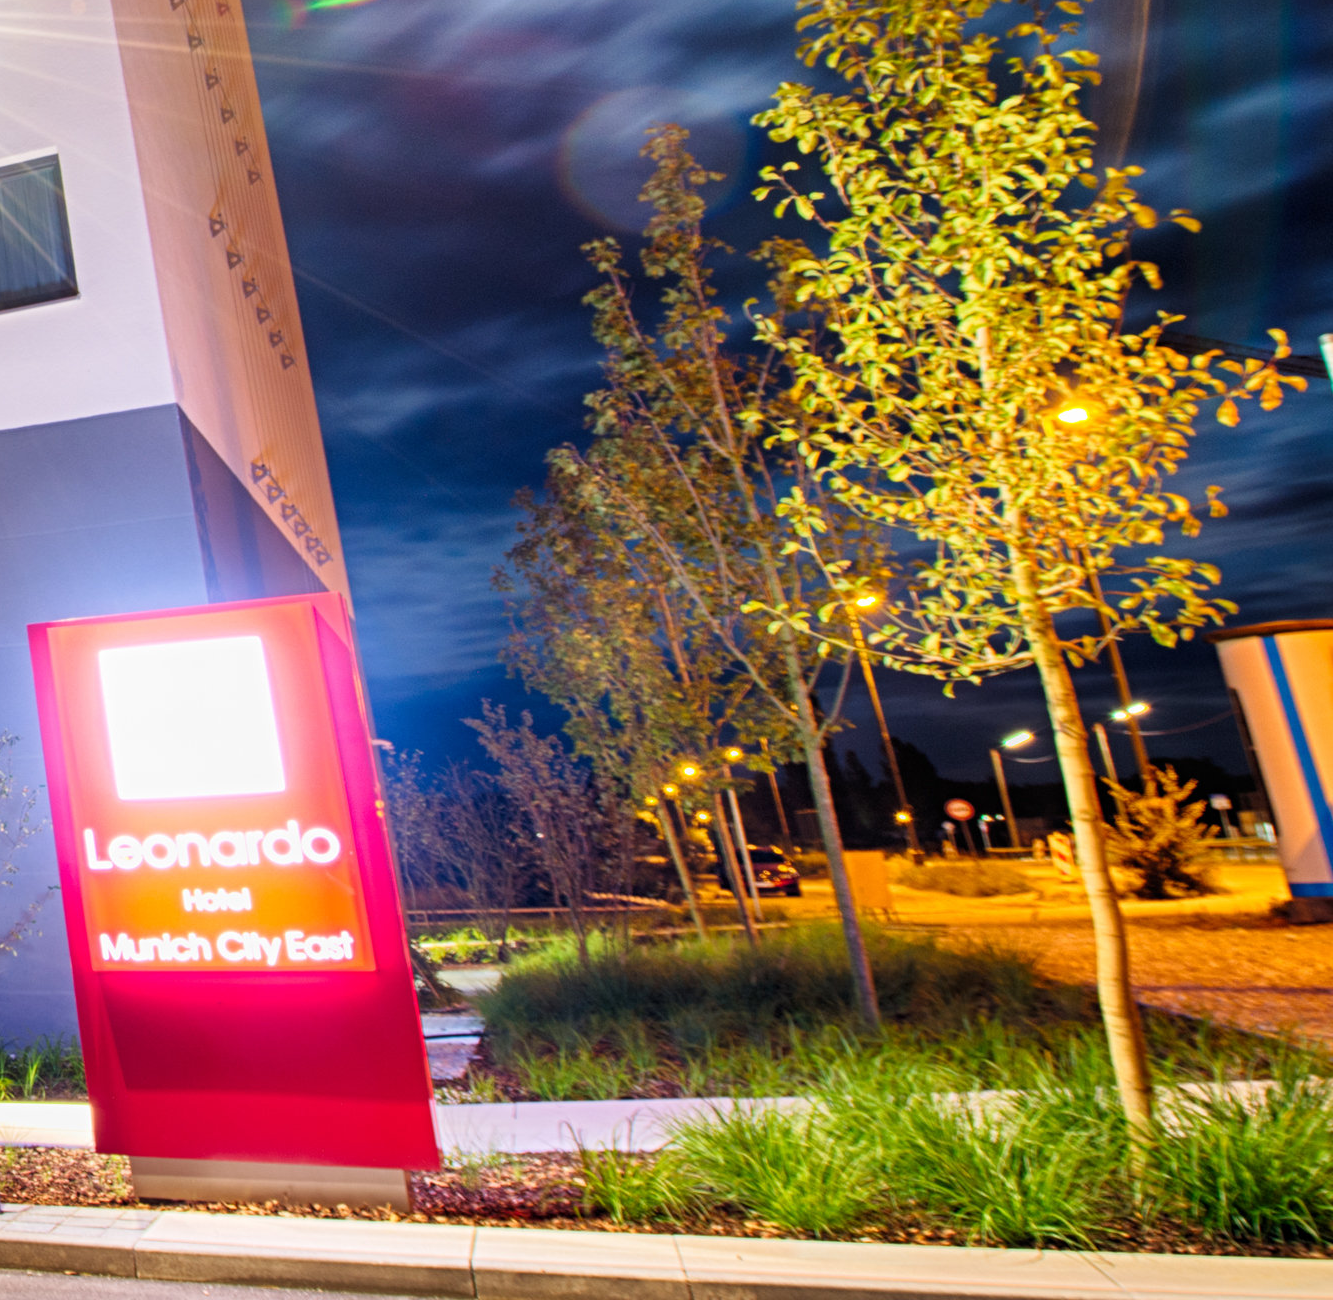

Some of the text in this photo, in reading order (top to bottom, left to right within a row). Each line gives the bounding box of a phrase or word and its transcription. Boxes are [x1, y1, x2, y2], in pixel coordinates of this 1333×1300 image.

[83, 818, 341, 870] Leonardo
[181, 886, 252, 912] Hotel
[99, 929, 355, 967] Munich City East
